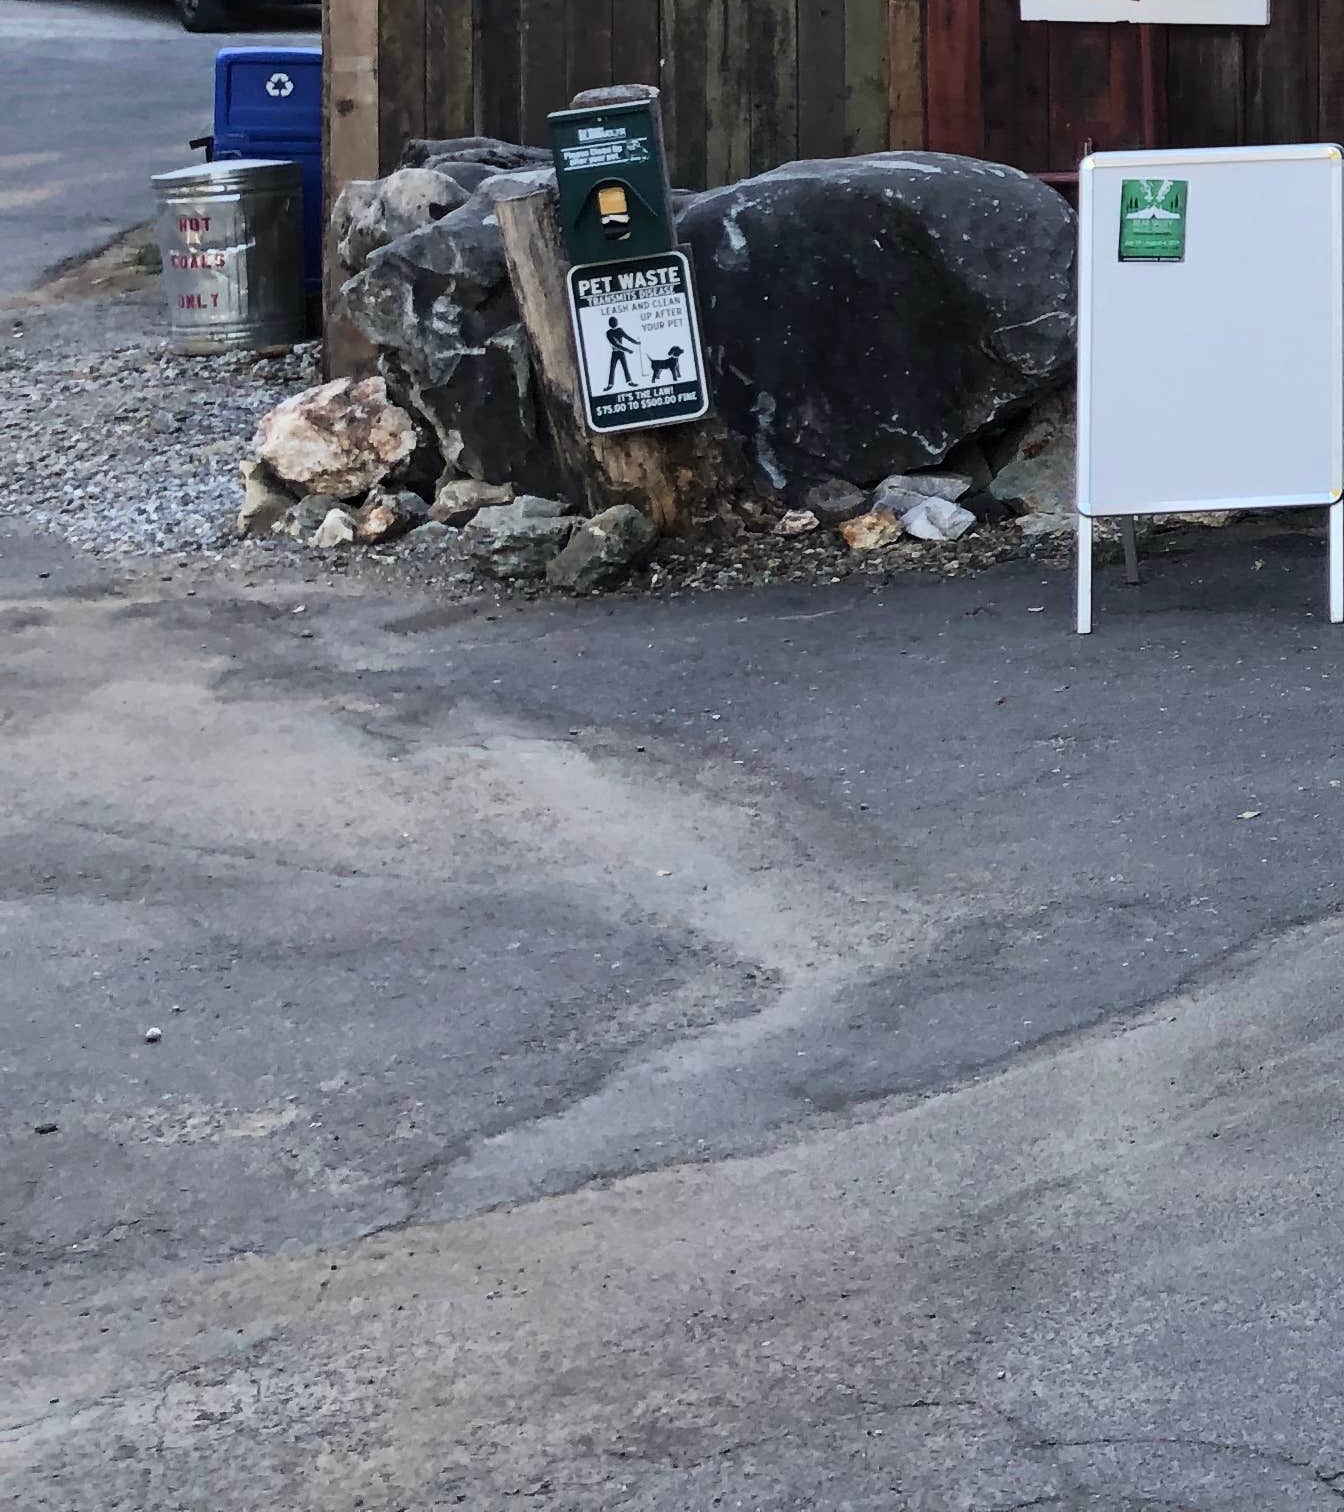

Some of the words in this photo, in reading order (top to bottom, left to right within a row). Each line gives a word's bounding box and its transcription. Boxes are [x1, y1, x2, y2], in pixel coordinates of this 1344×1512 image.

[178, 217, 210, 232] HOT
[171, 253, 226, 269] COALS
[578, 276, 612, 297] PET
[617, 266, 681, 290] WASTE
[177, 292, 219, 309] ONLY
[587, 290, 637, 308] TRANSMITS
[638, 285, 676, 300] DISEASE
[600, 302, 629, 316] LEASH
[631, 299, 650, 310] AND
[651, 295, 681, 308] CLEAN
[640, 311, 651, 322] UP
[655, 307, 682, 320] AFTER
[641, 322, 665, 333] YOUR
[667, 318, 684, 329] PET
[617, 393, 634, 403] IT'S
[635, 390, 652, 399] THE
[653, 386, 674, 397] LAW!
[596, 403, 627, 417] $75.00
[628, 400, 639, 410] TO
[640, 396, 677, 409] $500.00
[677, 391, 698, 403] FINE
